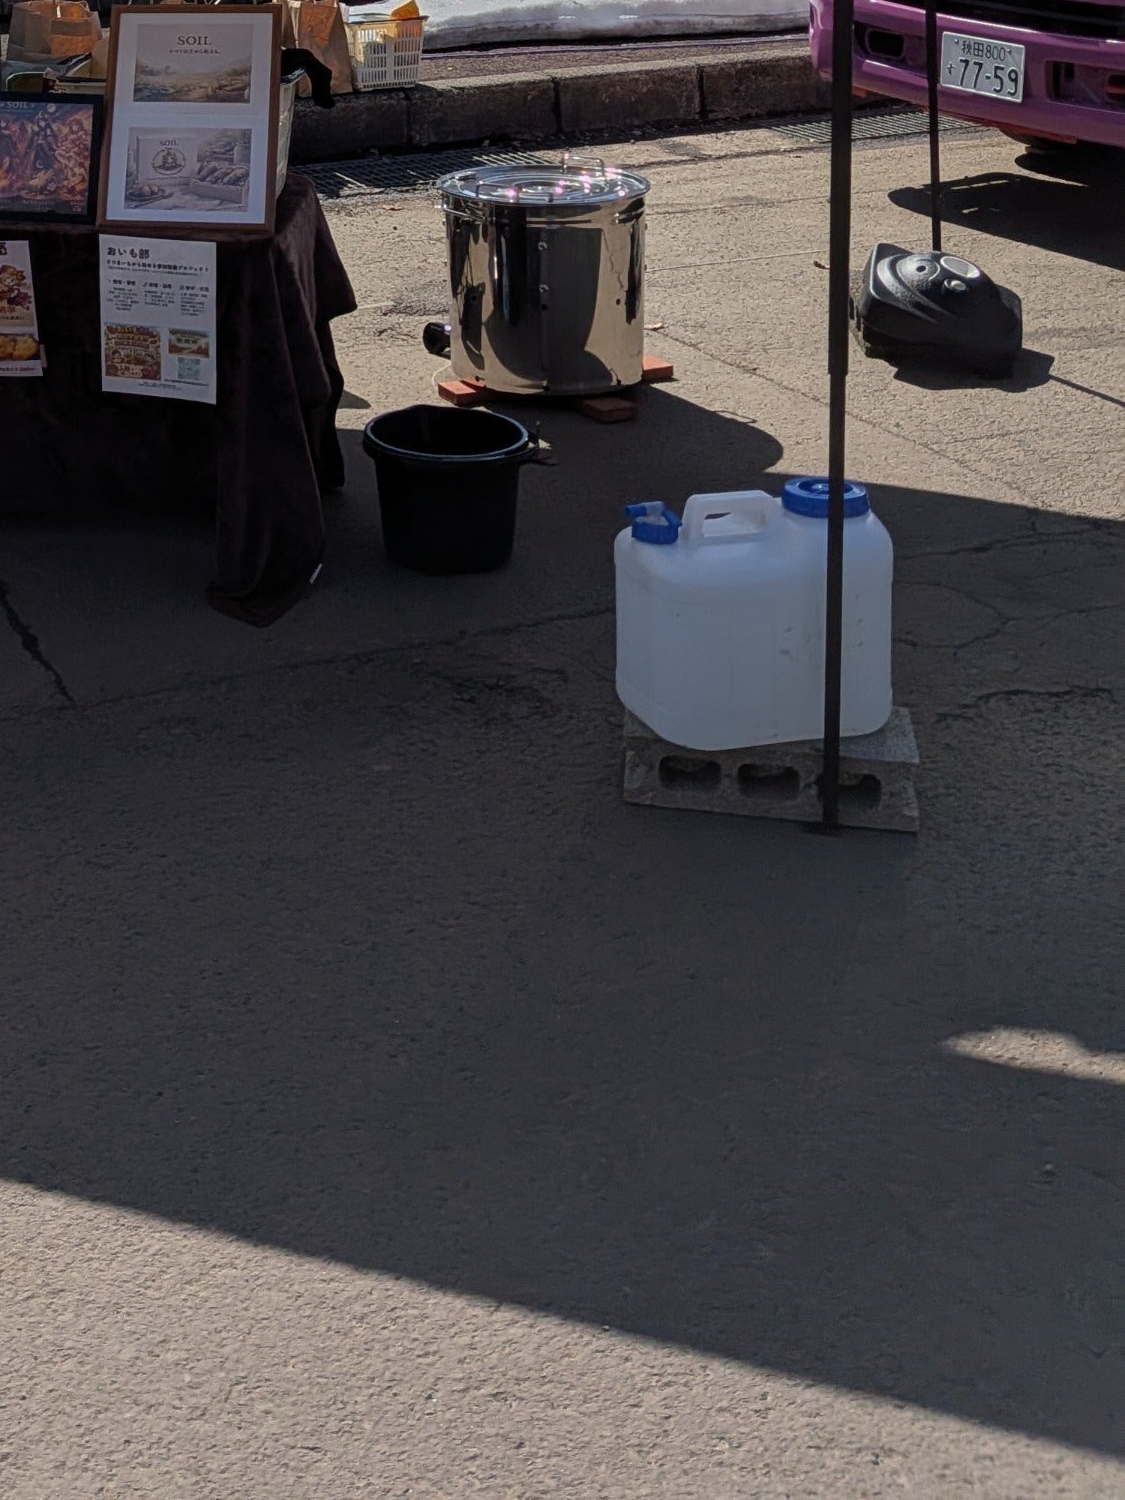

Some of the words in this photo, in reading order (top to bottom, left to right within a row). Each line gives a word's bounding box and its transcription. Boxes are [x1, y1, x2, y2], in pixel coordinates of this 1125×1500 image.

[177, 35, 212, 46] SOIL
[959, 58, 1019, 96] 77-59
[7, 101, 29, 109] SOIL
[107, 246, 150, 260] おいも部
